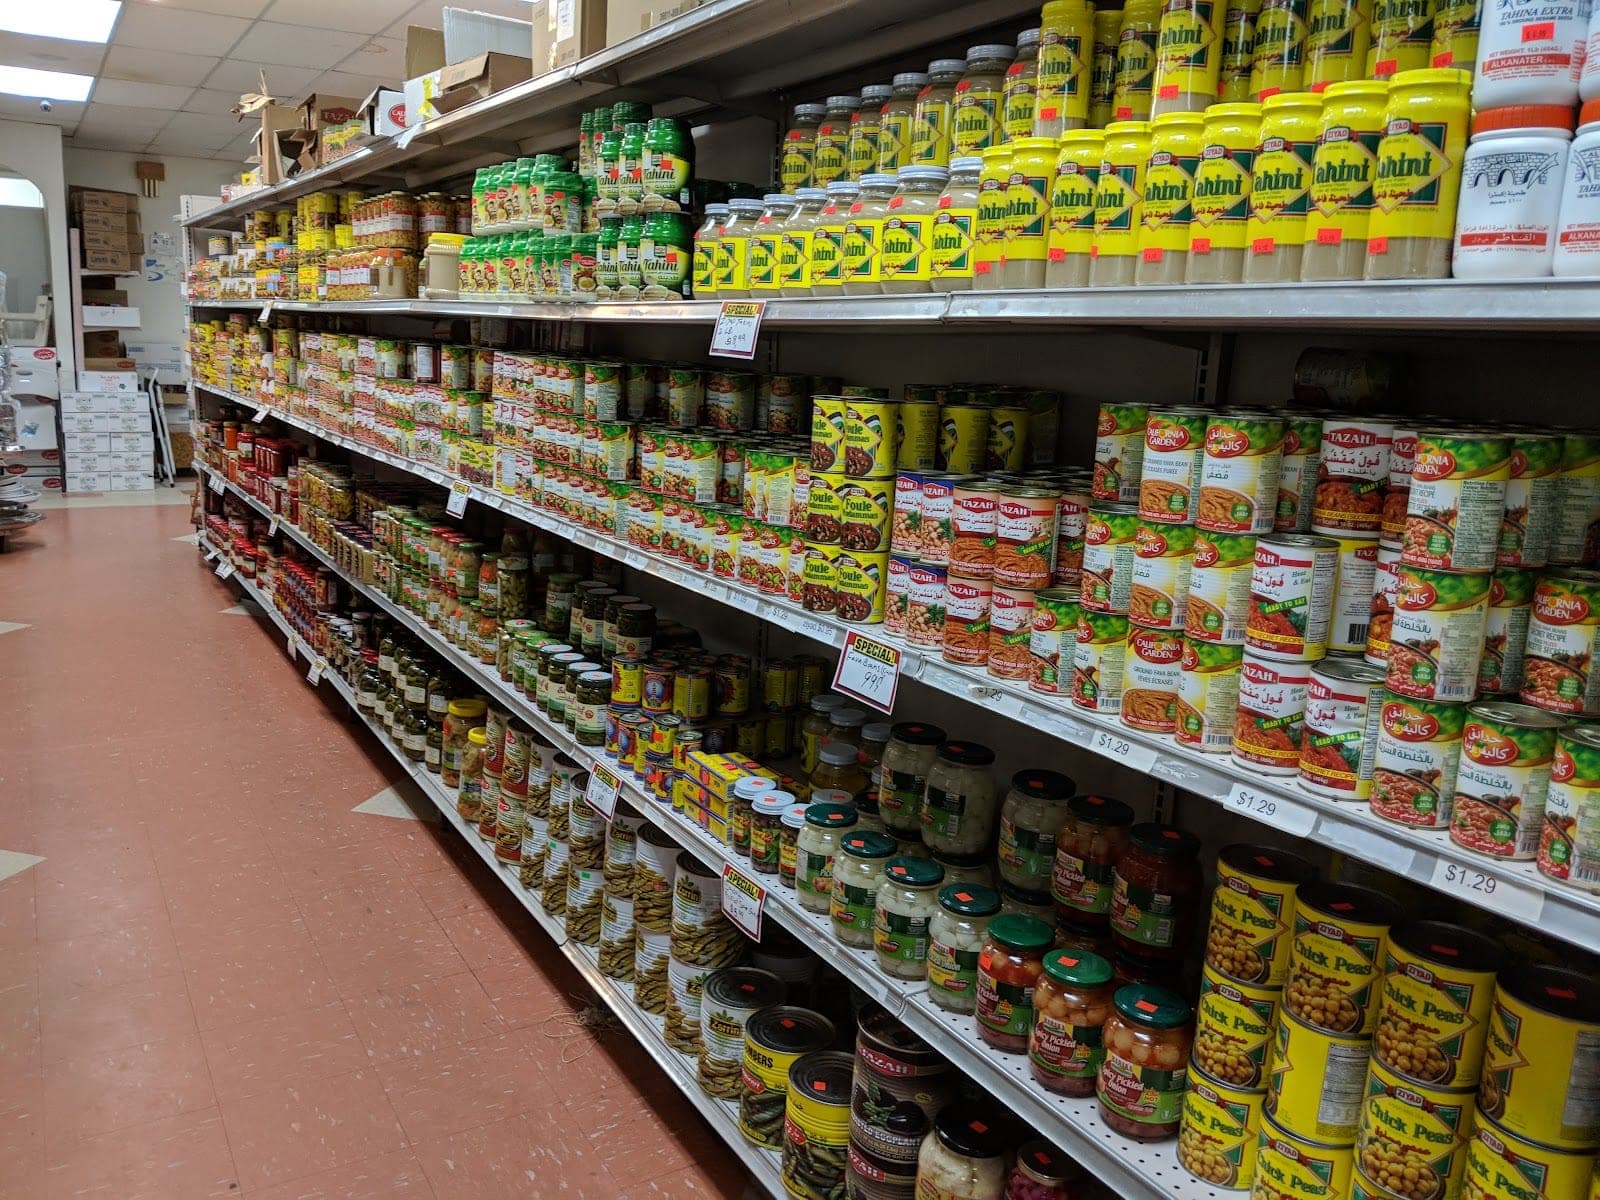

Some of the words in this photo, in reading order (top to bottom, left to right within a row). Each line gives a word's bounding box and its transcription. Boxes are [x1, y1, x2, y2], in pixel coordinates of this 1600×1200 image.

[1311, 8, 1346, 34] hini
[1501, 8, 1537, 20] TAHINA
[1541, 7, 1573, 15] EXTRA
[1162, 25, 1203, 47] ahini
[1254, 19, 1295, 47] ahini
[1041, 57, 1072, 75] hini
[1116, 54, 1149, 73] ahini
[1491, 56, 1543, 68] ALKANATER
[958, 116, 988, 132] ahini
[783, 159, 807, 175] ahini
[1314, 158, 1370, 184] ahini
[1377, 152, 1431, 179] ahini
[1194, 174, 1243, 196] ahini
[1254, 168, 1303, 191] ahini
[1055, 188, 1094, 207] ahini
[1145, 180, 1188, 201] ahini
[1097, 190, 1125, 208] hini
[978, 202, 1006, 220] ahin
[1007, 198, 1038, 217] hini
[935, 232, 963, 250] ahini
[813, 247, 837, 263] ahini
[1330, 432, 1370, 444] TAZAH
[1394, 441, 1416, 452] TAZA
[1415, 454, 1449, 466] LIFORNIA
[1414, 463, 1438, 474] ARDEN
[810, 491, 833, 503] Foule
[846, 499, 872, 511] Foule
[963, 501, 993, 509] TAZAH
[1001, 505, 1027, 515] TAZAH
[806, 559, 829, 573] Foule
[1256, 553, 1278, 565] ZAH
[839, 567, 862, 582] Foule
[889, 564, 905, 572] ZAH
[950, 586, 977, 596] TAZAH
[855, 637, 896, 665] SPECIAL!
[1142, 648, 1173, 659] GARDEN
[1134, 666, 1152, 675] GROUND
[1309, 683, 1328, 697] ZAH
[1389, 707, 1424, 721] حدائق
[1467, 727, 1503, 743] حدائق
[1099, 733, 1129, 756] $1.29
[1236, 791, 1276, 816] $1.29
[729, 871, 759, 898] SPECIAL!
[1230, 878, 1249, 893] ZIYAD
[1445, 864, 1497, 894] $1.29
[1241, 908, 1277, 930] Peas
[1319, 925, 1343, 938] ZIYAD
[1295, 939, 1329, 969] Chick
[1334, 955, 1372, 975] Peas
[1408, 965, 1432, 981] ZIYAD
[1221, 986, 1241, 1000] ZIYAD
[1423, 1001, 1465, 1025] Peas
[1233, 1015, 1267, 1035] Peas
[1041, 1041, 1060, 1053] Onion
[1049, 1036, 1076, 1048] Pickled
[748, 1045, 773, 1069] MBERS
[859, 1048, 908, 1075] TAZAH
[1108, 1081, 1127, 1095] Onion
[1117, 1076, 1145, 1091] Pickled
[1199, 1086, 1217, 1100] ZIYAD
[1397, 1089, 1423, 1106] ZIYAD
[1210, 1115, 1244, 1138] Peas
[1369, 1099, 1408, 1135] Chick
[1412, 1123, 1454, 1144] Peas
[1277, 1142, 1297, 1157] ZIYAD
[1481, 1130, 1504, 1154] ZIYAD
[1468, 1149, 1490, 1182] hick
[1495, 1170, 1538, 1200] Peas
[1291, 1172, 1327, 1195] Peas
